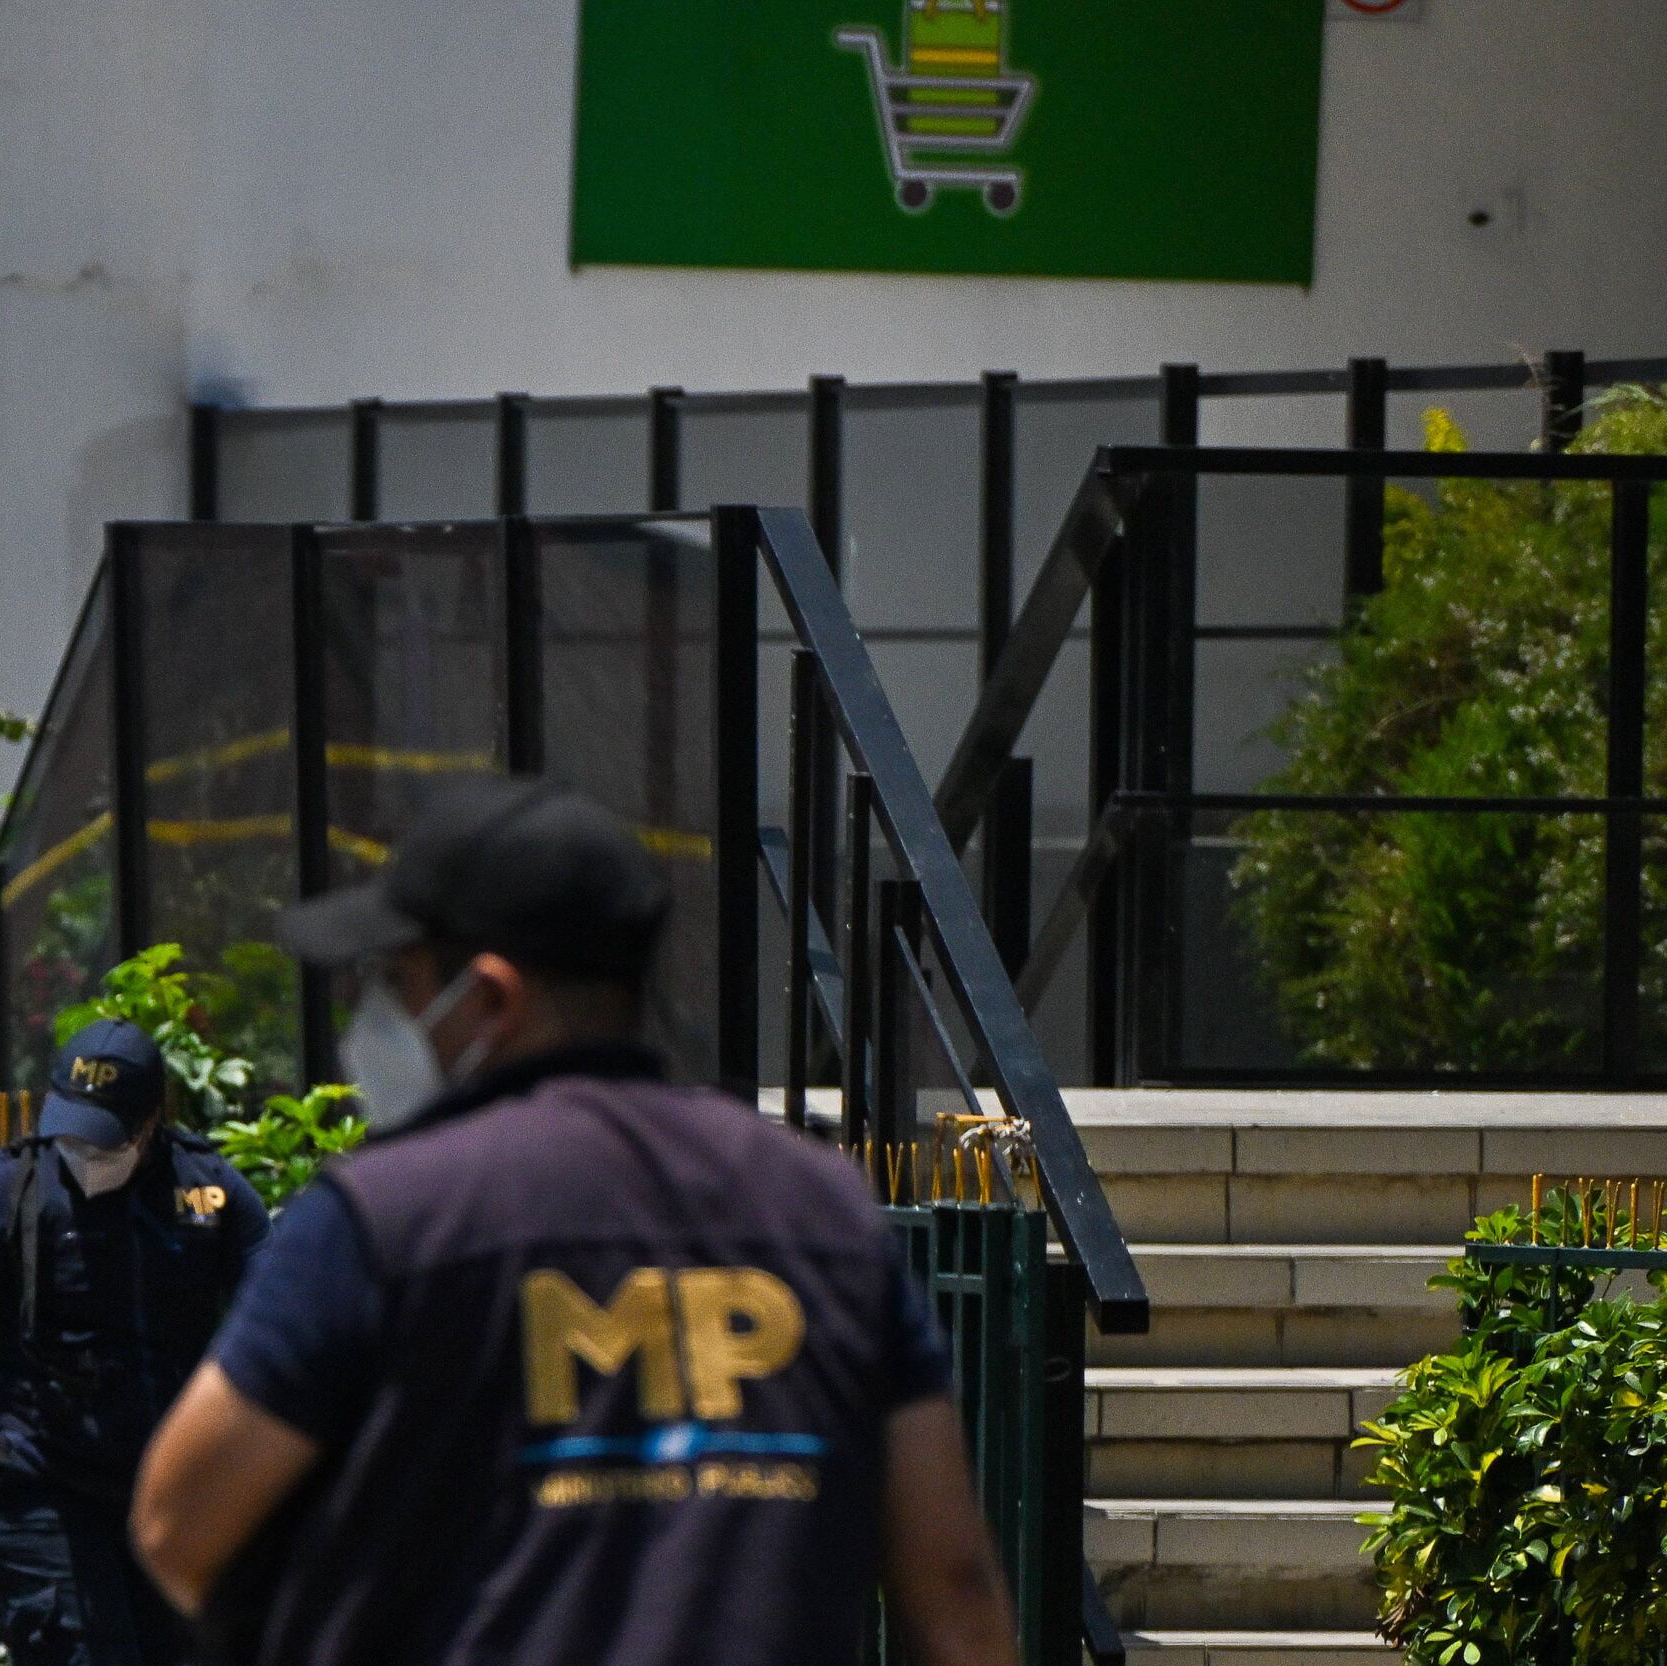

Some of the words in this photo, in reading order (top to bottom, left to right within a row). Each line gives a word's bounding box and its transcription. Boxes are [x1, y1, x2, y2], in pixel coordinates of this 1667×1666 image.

[70, 1056, 118, 1087] MP
[174, 1185, 226, 1216] MP
[519, 1266, 806, 1426] MP
